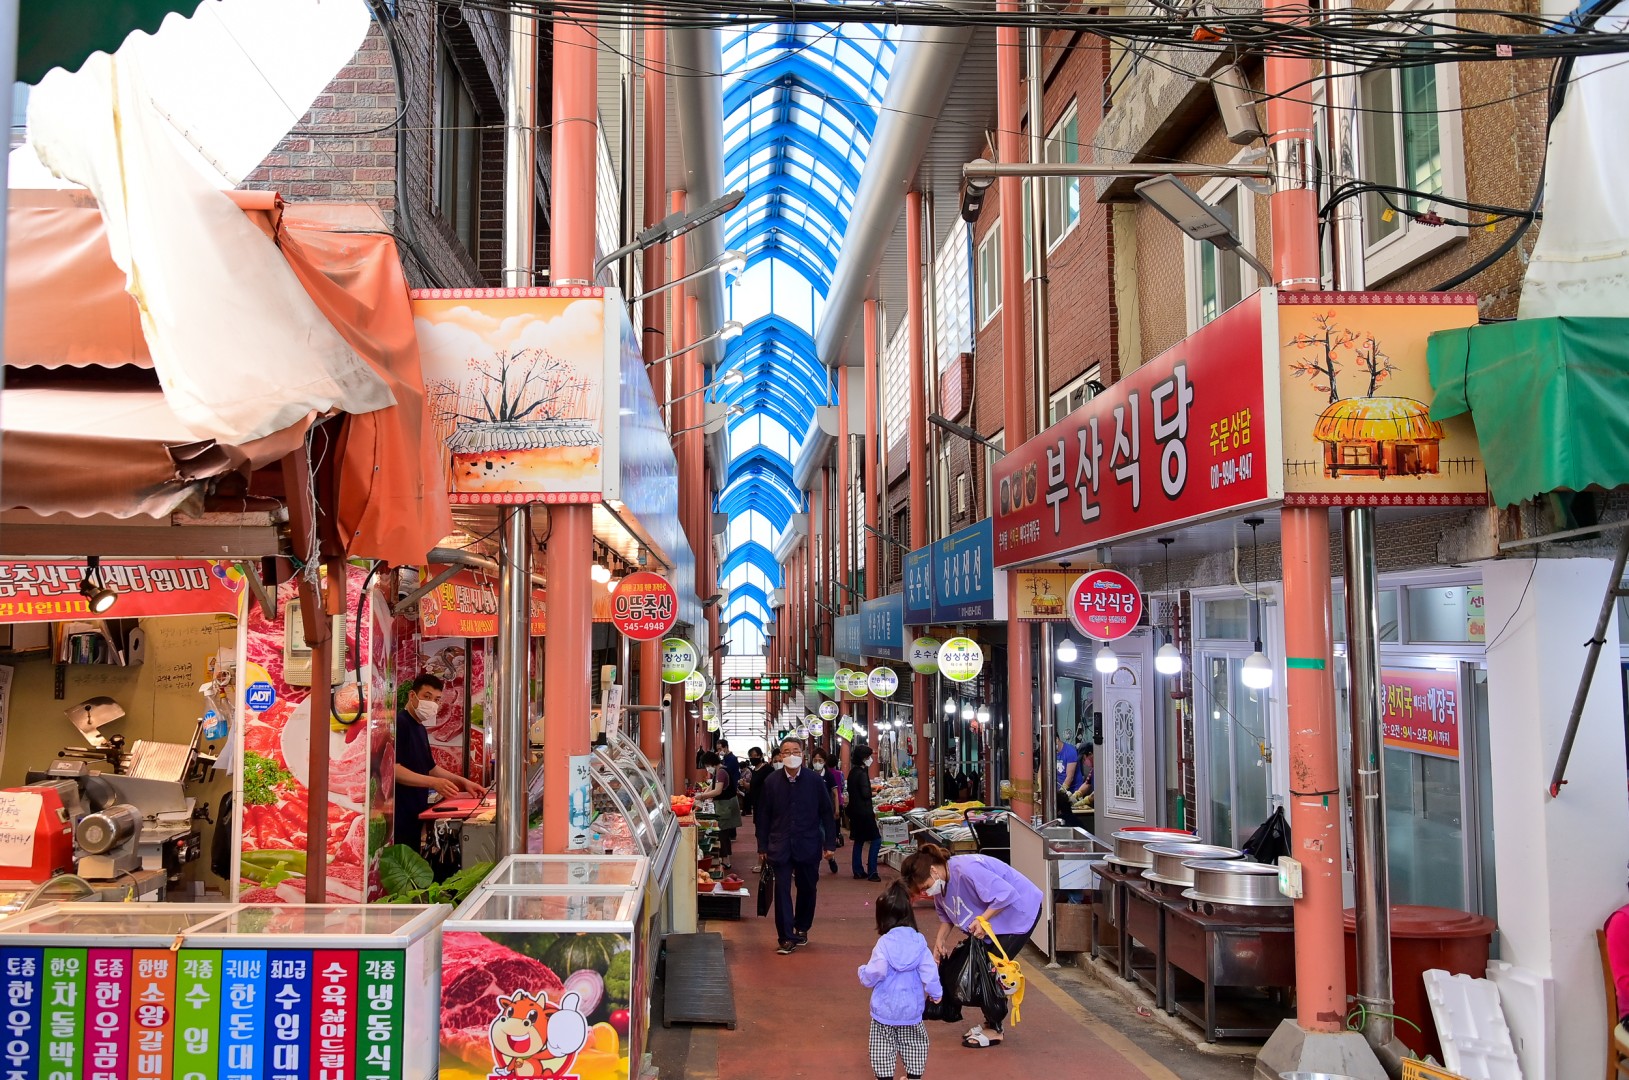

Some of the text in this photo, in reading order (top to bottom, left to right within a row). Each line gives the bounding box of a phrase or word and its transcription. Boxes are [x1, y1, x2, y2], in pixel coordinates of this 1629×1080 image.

[1209, 408, 1252, 456] 주문상담
[1046, 364, 1193, 535] 부산식당
[943, 545, 982, 599] 싱싱생선
[615, 593, 673, 620] 으뜸축산
[1079, 592, 1136, 613] 부산식당
[624, 622, 665, 631] 545-4948
[664, 653, 692, 663] 장상회
[944, 652, 980, 662] 싱싱생선
[250, 691, 271, 702] ADT
[1387, 684, 1413, 719] 선지국
[1427, 687, 1456, 725] 해장국
[6, 957, 36, 977] 토종
[50, 958, 80, 978] 한우
[94, 959, 124, 978] 토종
[138, 959, 168, 979] 한방
[184, 959, 213, 979] 각종
[226, 960, 261, 979] 국내산
[271, 960, 306, 980] 최고급
[365, 960, 395, 980] 각종
[137, 983, 166, 1080] 소왕갈비
[227, 984, 257, 1080] 한돈대
[272, 984, 302, 1080] 수입대
[364, 985, 394, 1080] 냉동식
